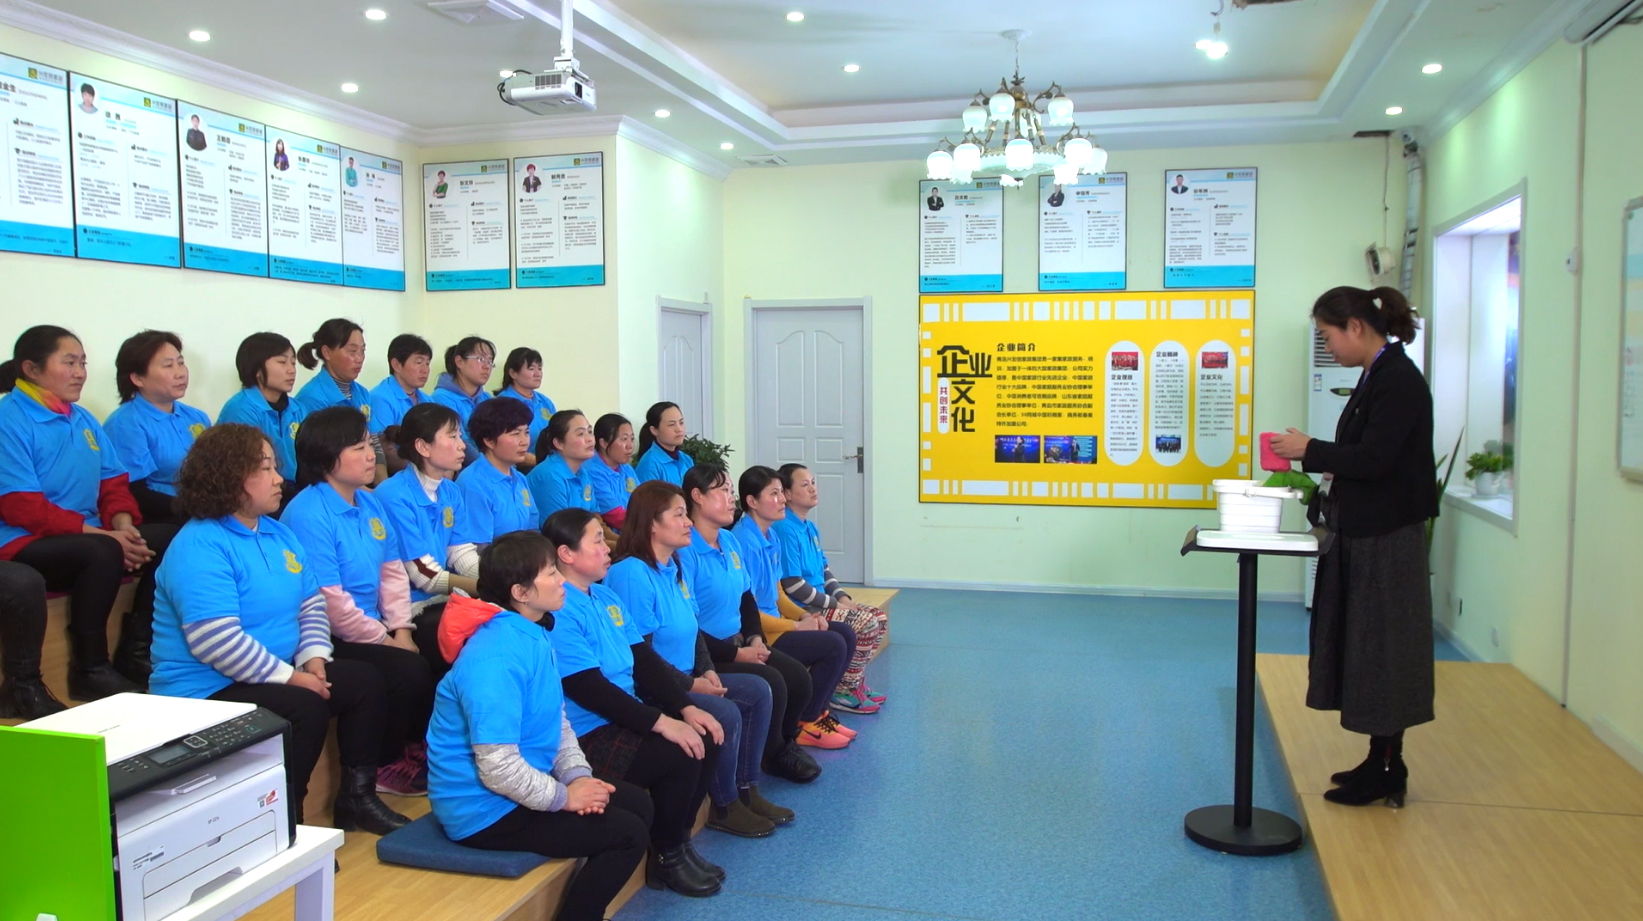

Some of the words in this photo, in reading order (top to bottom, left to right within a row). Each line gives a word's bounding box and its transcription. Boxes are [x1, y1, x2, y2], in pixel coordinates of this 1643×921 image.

[937, 345, 993, 378] 企业
[997, 343, 1036, 352] 企业简介
[939, 386, 949, 425] 共创未来
[951, 378, 976, 433] 文化
